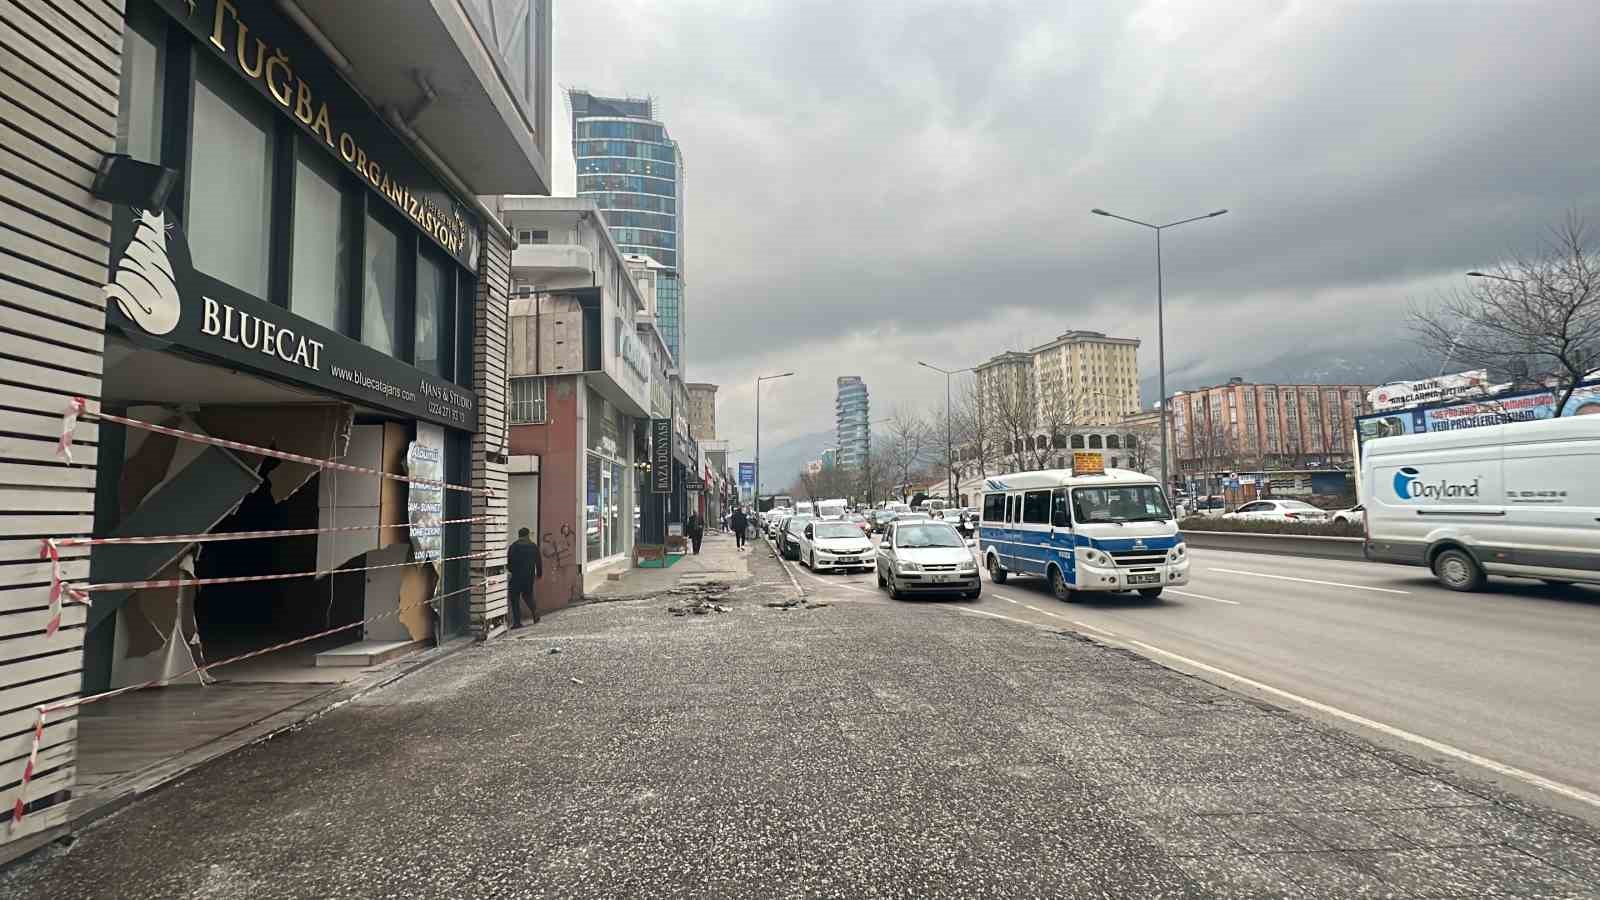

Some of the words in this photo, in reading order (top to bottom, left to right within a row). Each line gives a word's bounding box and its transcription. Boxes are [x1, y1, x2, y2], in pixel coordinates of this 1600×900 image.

[209, 0, 335, 148] TUĞBA
[340, 132, 457, 253] ORGANİZASYON
[201, 296, 324, 371] BLUECAT
[331, 364, 416, 402] www.bluecatajans.com
[419, 379, 442, 399] AJANS
[442, 391, 450, 402] &
[450, 390, 472, 410] STUDIO
[1413, 479, 1479, 500] Dayland
